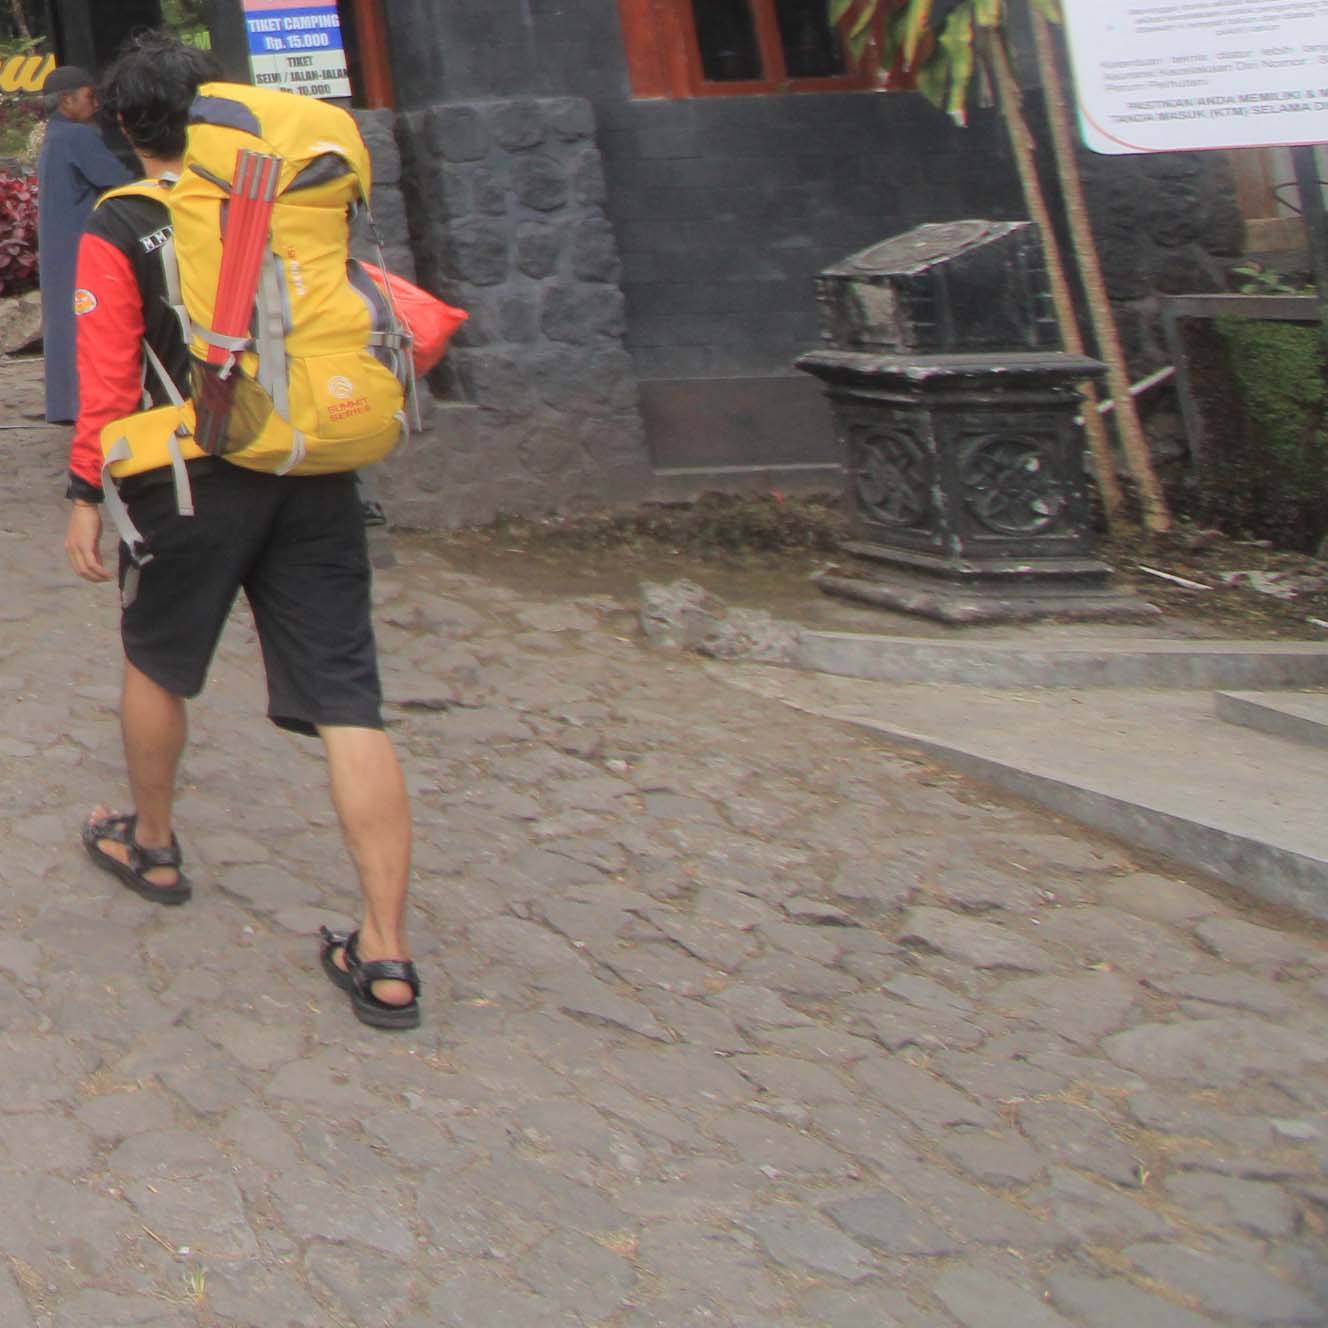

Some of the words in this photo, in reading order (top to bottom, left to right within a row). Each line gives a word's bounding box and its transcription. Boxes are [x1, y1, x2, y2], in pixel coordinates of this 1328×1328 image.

[247, 18, 282, 32] TIKET
[284, 14, 340, 31] CAMPING
[264, 35, 286, 50] Rp.
[287, 33, 329, 48] 15.000
[286, 55, 313, 68] TIKET
